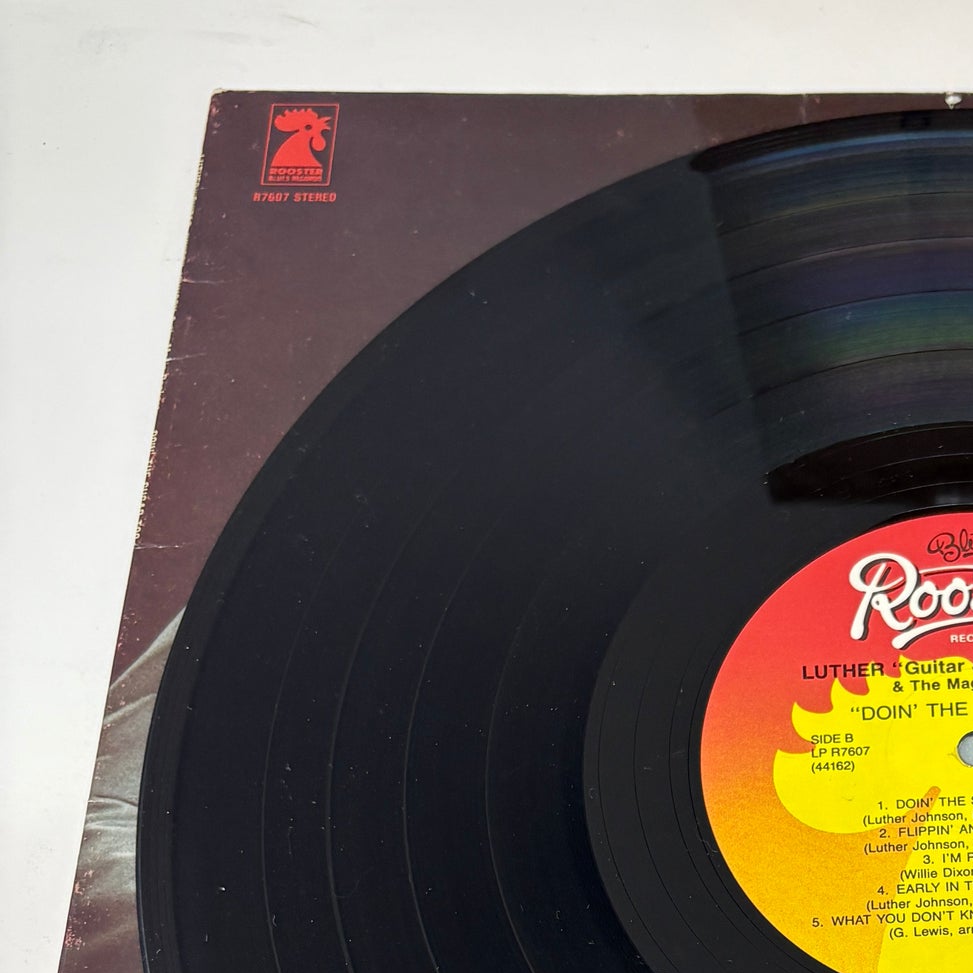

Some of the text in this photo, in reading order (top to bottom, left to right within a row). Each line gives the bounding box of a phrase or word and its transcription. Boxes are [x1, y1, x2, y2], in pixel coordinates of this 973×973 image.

[253, 192, 337, 202] R7607 STEREO
[801, 662, 885, 680] LUTHER
[892, 660, 965, 677] "Guitar
[892, 680, 905, 693] &
[909, 680, 941, 691] The
[850, 704, 918, 720] "DOIN'
[925, 702, 969, 717] THE
[809, 732, 855, 745] SIDE B
[811, 746, 871, 759] LP R7607
[811, 761, 856, 774] (44162)
[877, 800, 889, 811] 1.
[895, 798, 934, 809] DOIN'
[937, 796, 967, 806] THE
[862, 814, 907, 827] (Luther
[910, 812, 968, 824] Johnson,
[879, 827, 891, 839] 2.
[898, 824, 954, 837] FLIPPIN'
[863, 842, 909, 855] (Luther
[911, 840, 969, 852] Johnson,
[922, 853, 935, 865] 3.
[942, 853, 962, 863] I'M
[899, 869, 939, 882] (Willie
[876, 885, 889, 896] 4.
[896, 882, 941, 894] EARLY
[945, 880, 960, 893] IN
[866, 900, 911, 912] (Luther
[915, 898, 973, 908] Johnson,
[811, 917, 824, 928] 5.
[831, 915, 872, 926] WHAT
[876, 913, 906, 924] YOU
[911, 911, 955, 922] DON'T
[889, 927, 909, 940] (G.
[913, 926, 953, 936] Lewis,
